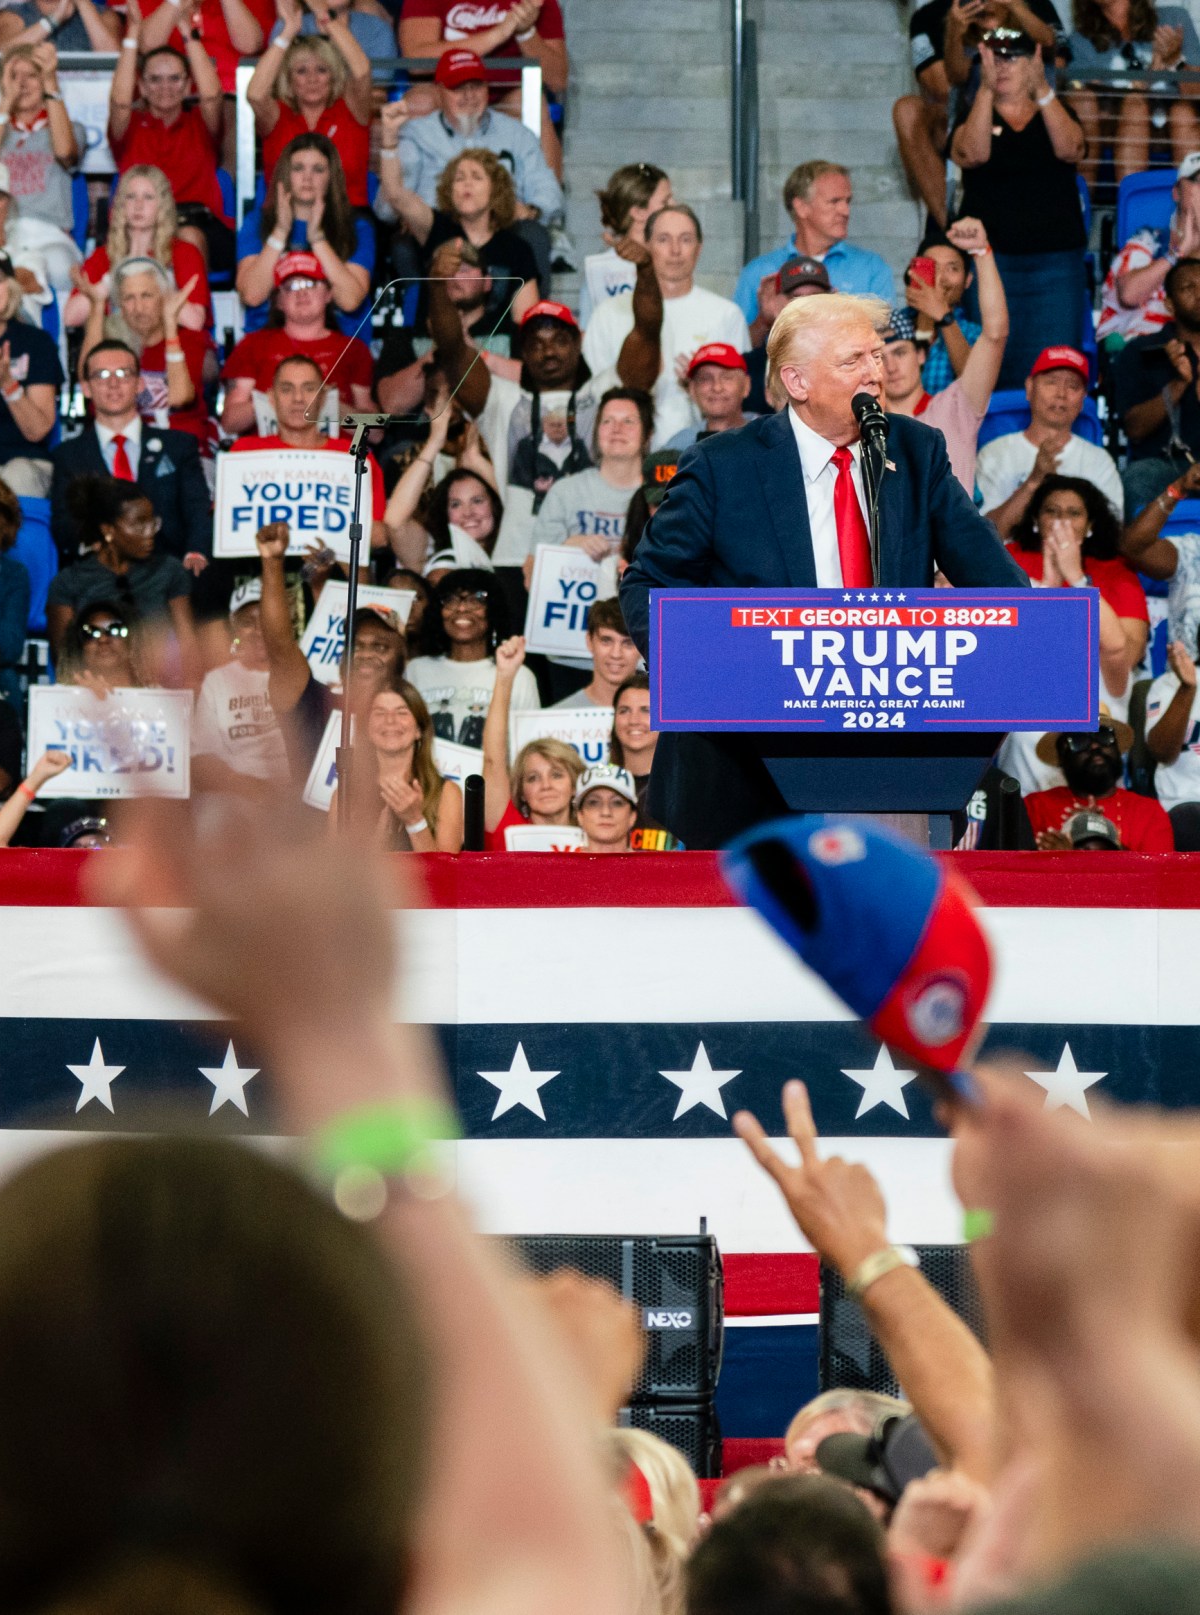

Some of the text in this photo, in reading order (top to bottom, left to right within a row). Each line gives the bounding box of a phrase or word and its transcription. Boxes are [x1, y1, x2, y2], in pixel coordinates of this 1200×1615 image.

[655, 465, 678, 482] US
[242, 483, 352, 506] YOU'RE
[576, 510, 623, 537] TRU
[559, 579, 597, 601] YO
[738, 609, 1012, 626] TEXT GEORGIA TO 88022
[307, 636, 345, 666] FIR
[771, 630, 978, 666] TRUMP
[794, 667, 954, 697] VANCE
[784, 700, 966, 709] MAKE AMERICA GREAT AGAIN!
[842, 711, 906, 728] 2024
[647, 1311, 692, 1329] NEXO
